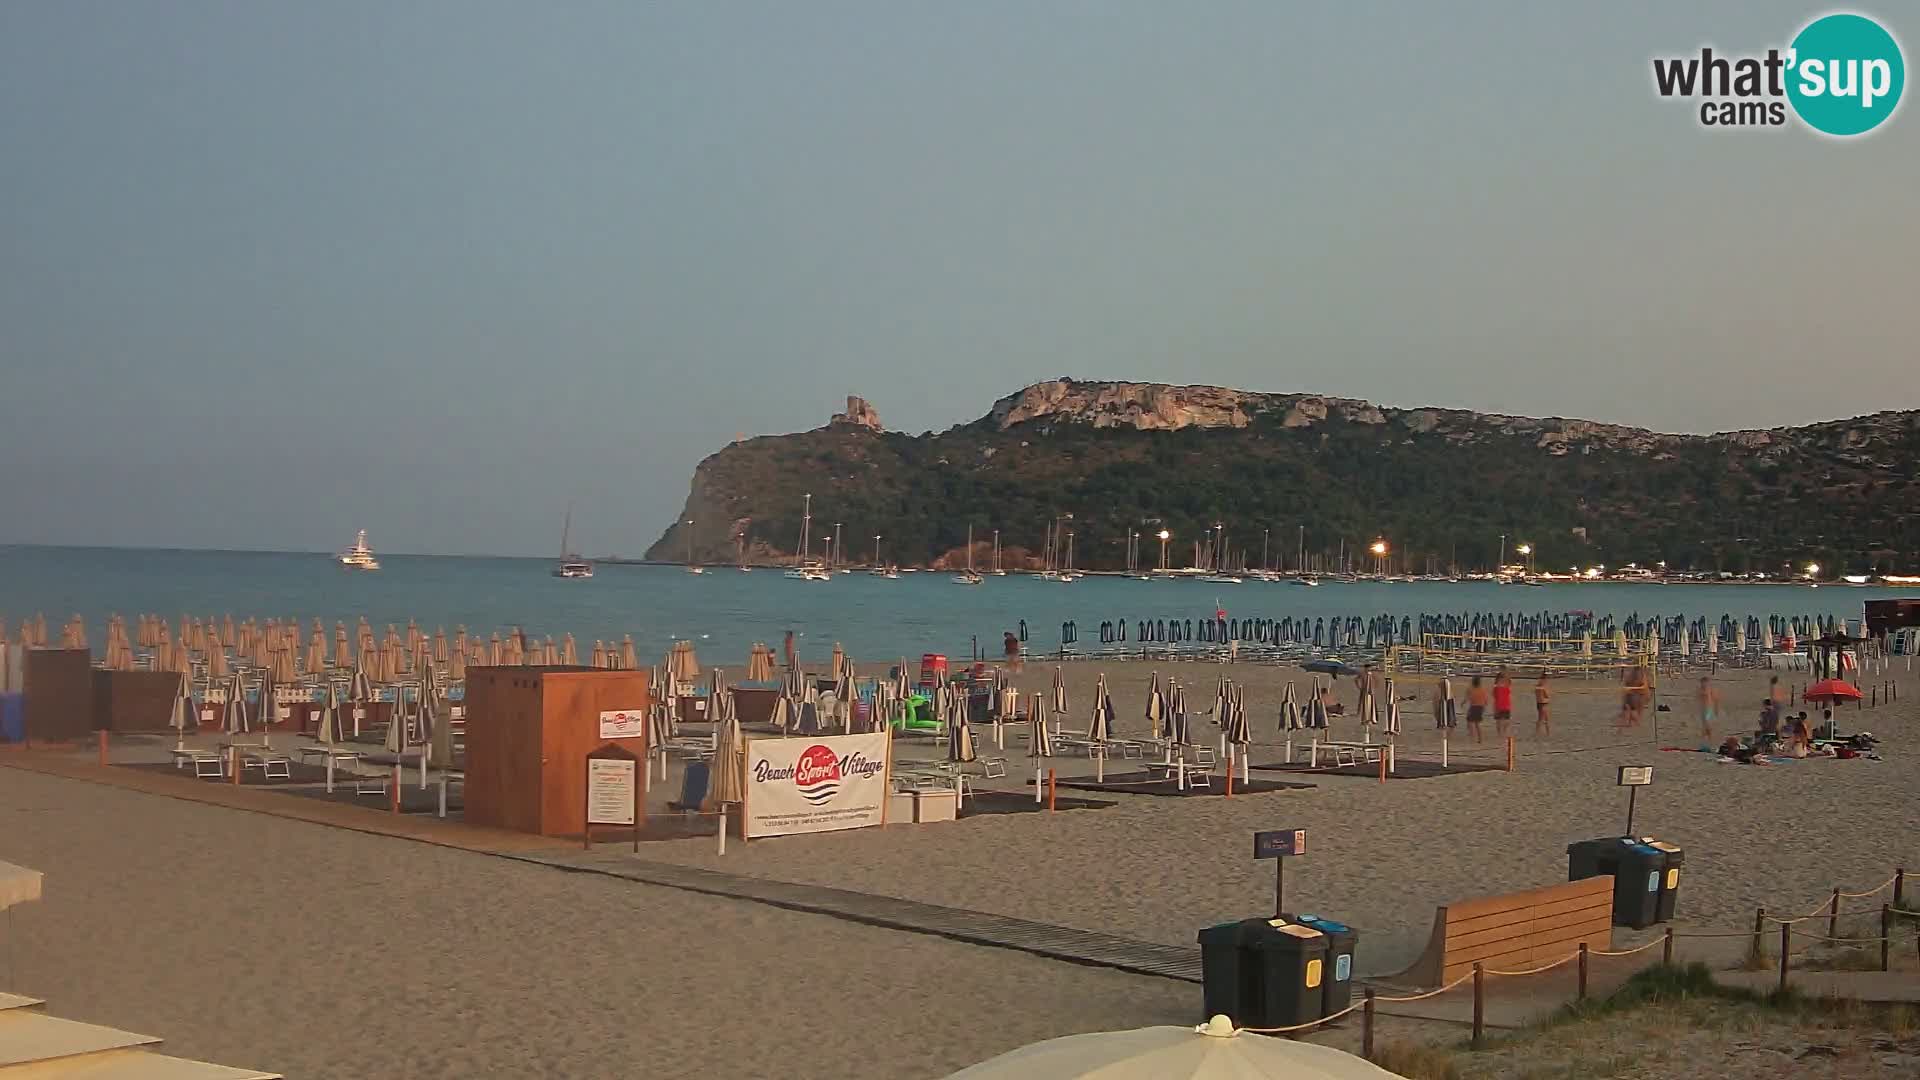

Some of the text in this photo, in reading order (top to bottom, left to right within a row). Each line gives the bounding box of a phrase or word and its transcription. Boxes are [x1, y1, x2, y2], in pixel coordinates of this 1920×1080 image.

[753, 751, 884, 783] Beach Sport Village
